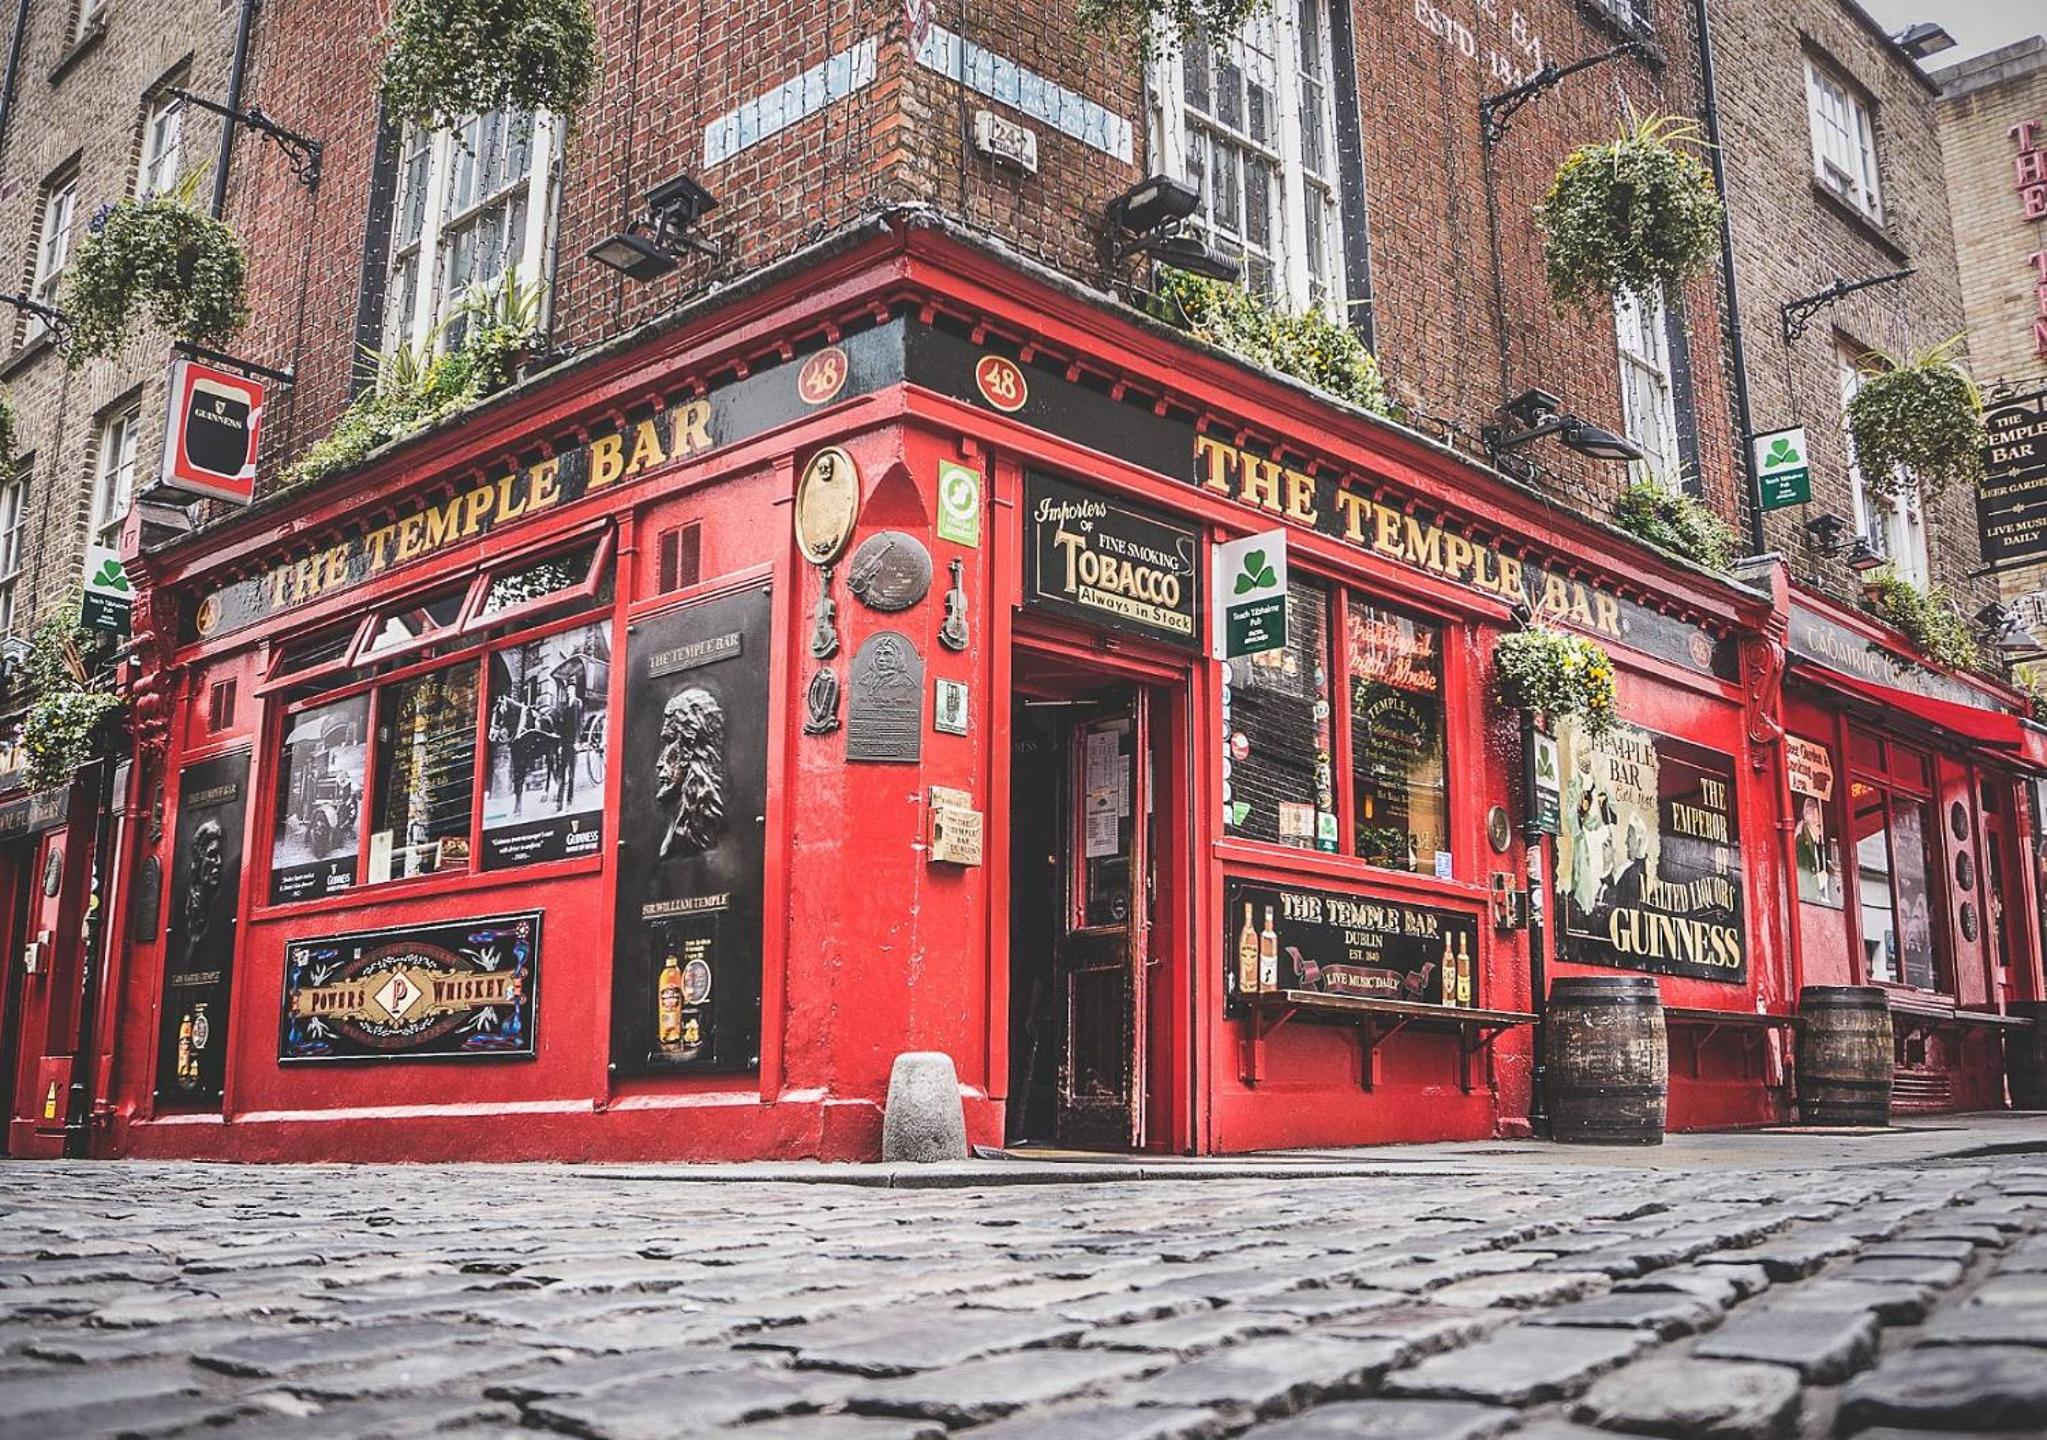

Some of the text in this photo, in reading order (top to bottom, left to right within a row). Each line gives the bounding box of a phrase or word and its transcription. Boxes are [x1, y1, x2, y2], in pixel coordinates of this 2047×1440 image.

[806, 357, 838, 393] 48
[985, 363, 1017, 400] 48
[194, 408, 243, 430] GUINNESS
[1988, 421, 2047, 447] EMPLE
[1994, 413, 2023, 428] THE
[1992, 444, 2035, 464] BAR
[270, 399, 713, 607] THE TEMPLE BAR
[1034, 497, 1107, 530] Importers
[1080, 520, 1094, 533] OF
[1197, 434, 1624, 637] THE TEMPLE BAR
[1987, 516, 2047, 537] LIVE MUSI
[2003, 531, 2041, 547] DAILY
[1054, 529, 1180, 609] TOBACCO
[1098, 534, 1180, 570] FINE SMOKING
[1081, 587, 1190, 630] Always in Stock
[650, 633, 739, 669] THE TEMPLE BAR
[1368, 697, 1407, 719] TEMPLE
[1609, 758, 1642, 791] BAR
[1700, 777, 1727, 811] THE
[1672, 802, 1729, 844] EMPEROR
[1714, 847, 1730, 876] OF
[1639, 872, 1736, 913] MALTED LIQUORS
[1280, 892, 1440, 940] THE TEMPLE BAR
[1344, 930, 1384, 948] DUBLIN
[1609, 907, 1742, 969] GUINNESS
[1349, 949, 1365, 962] EST.
[311, 977, 506, 1013] POWERS WHISKEY
[392, 979, 408, 1014] P
[1326, 972, 1401, 991] LIVE MUSIC DAILY
